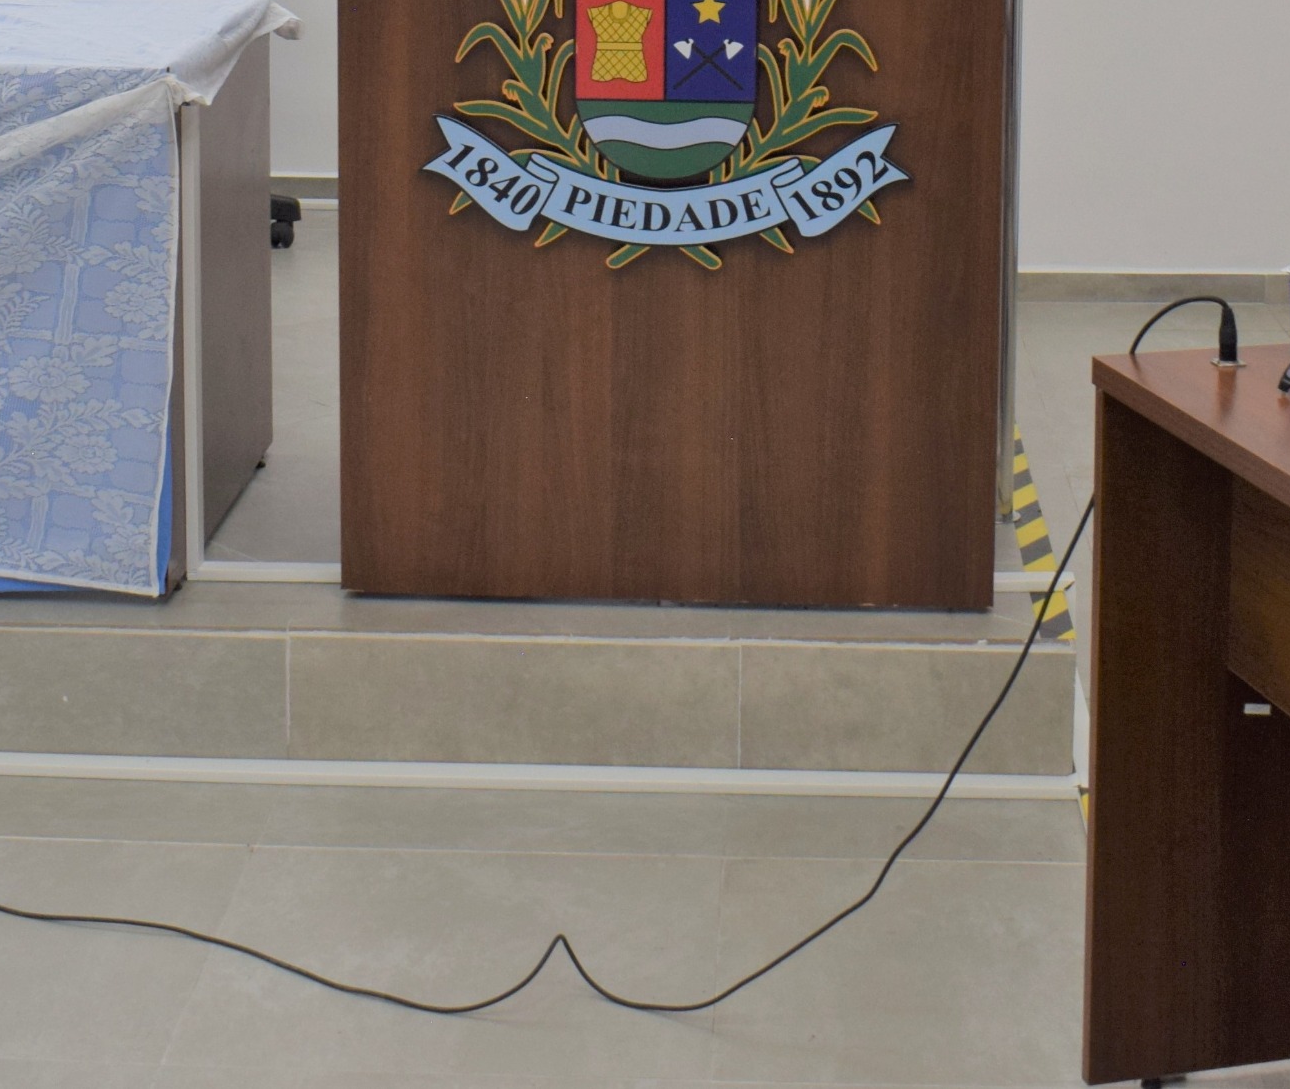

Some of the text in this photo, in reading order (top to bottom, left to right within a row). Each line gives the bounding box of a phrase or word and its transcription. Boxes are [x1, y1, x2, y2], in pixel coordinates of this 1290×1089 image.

[444, 143, 890, 232] 1840 PIEDADE 1892
